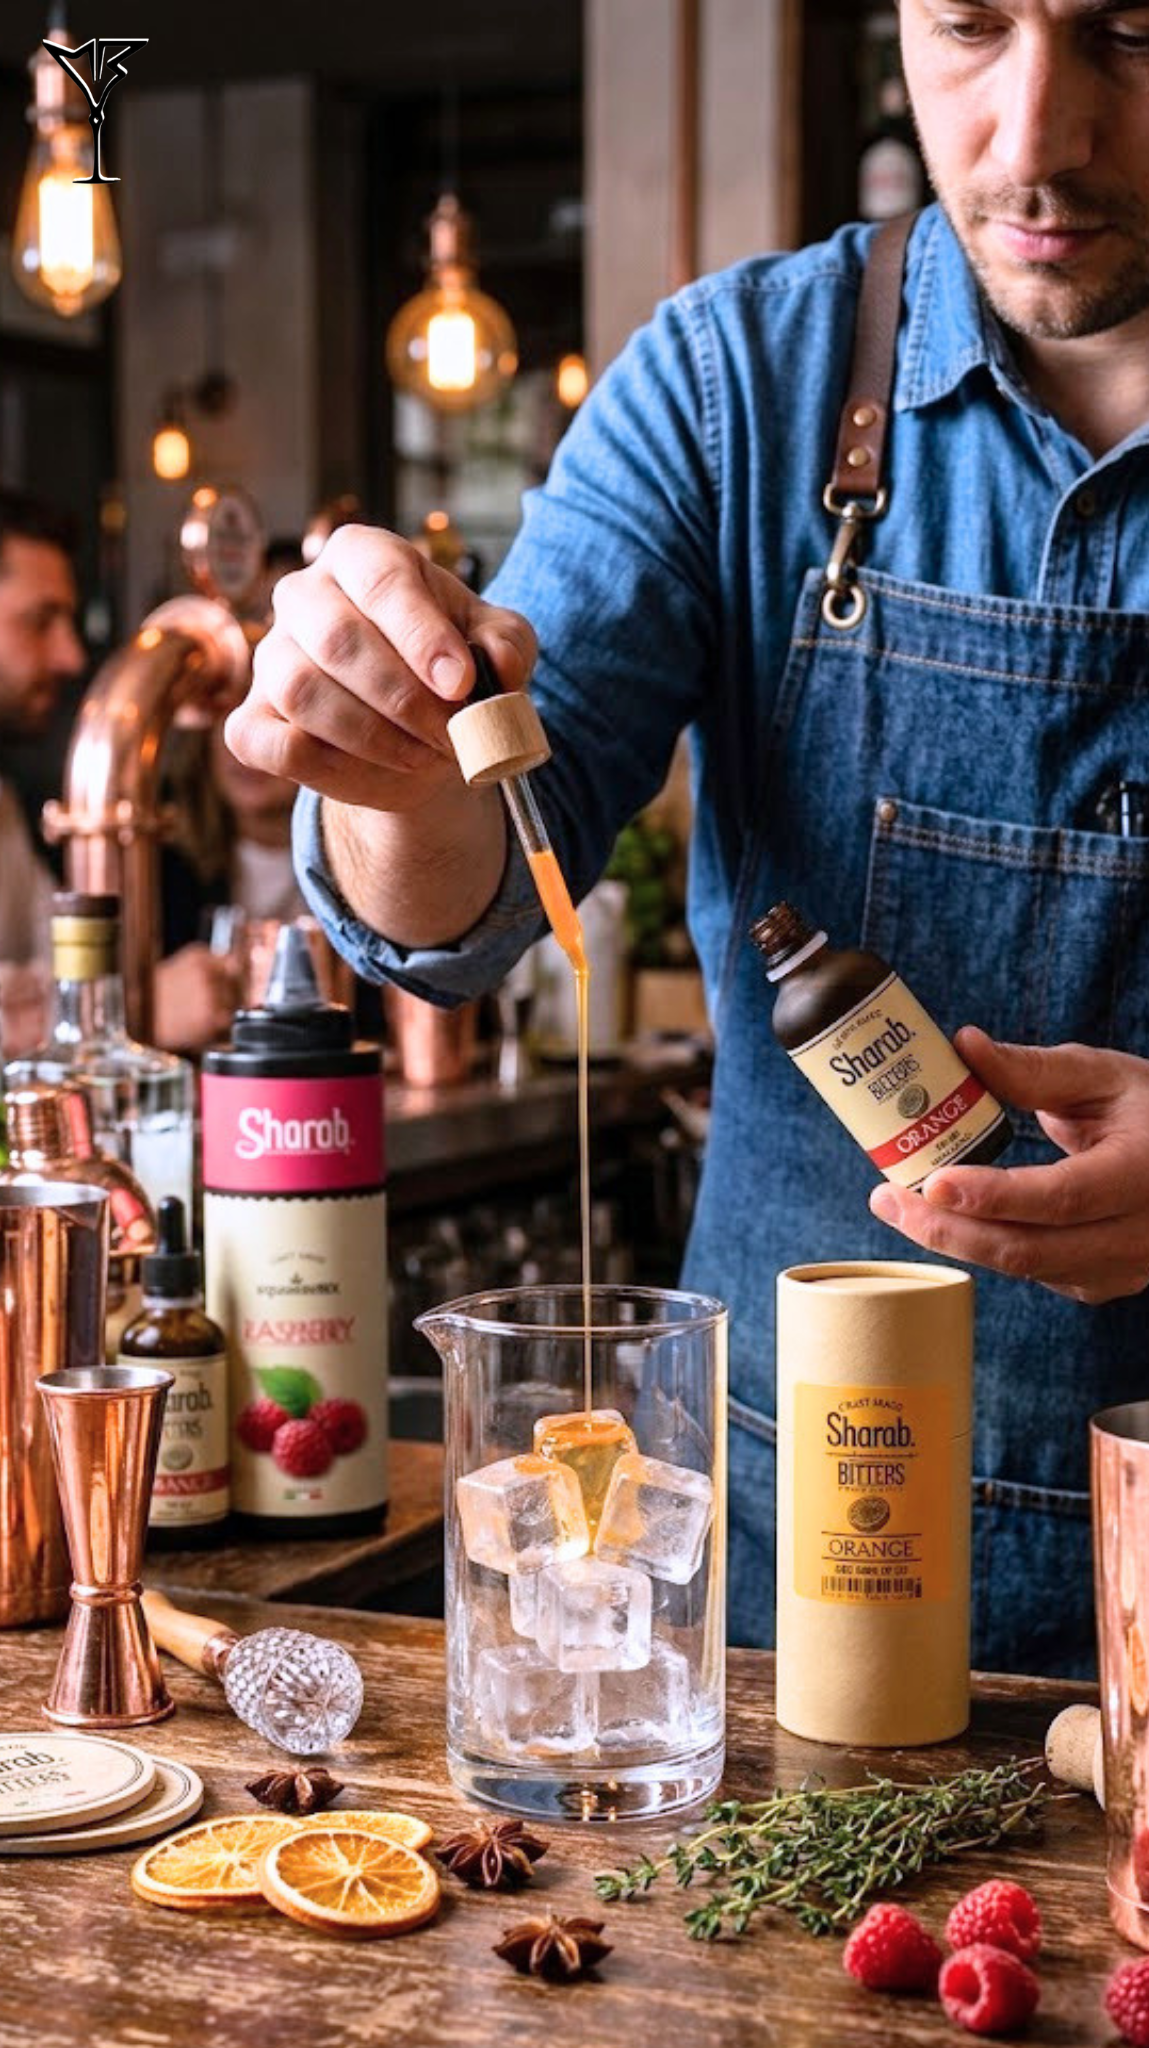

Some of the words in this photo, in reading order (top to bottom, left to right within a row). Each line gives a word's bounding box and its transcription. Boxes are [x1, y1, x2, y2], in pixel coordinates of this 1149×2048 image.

[896, 1095, 968, 1153] ORANGE
[838, 1462, 905, 1485] BITTERS
[829, 1539, 914, 1558] ORANGE
